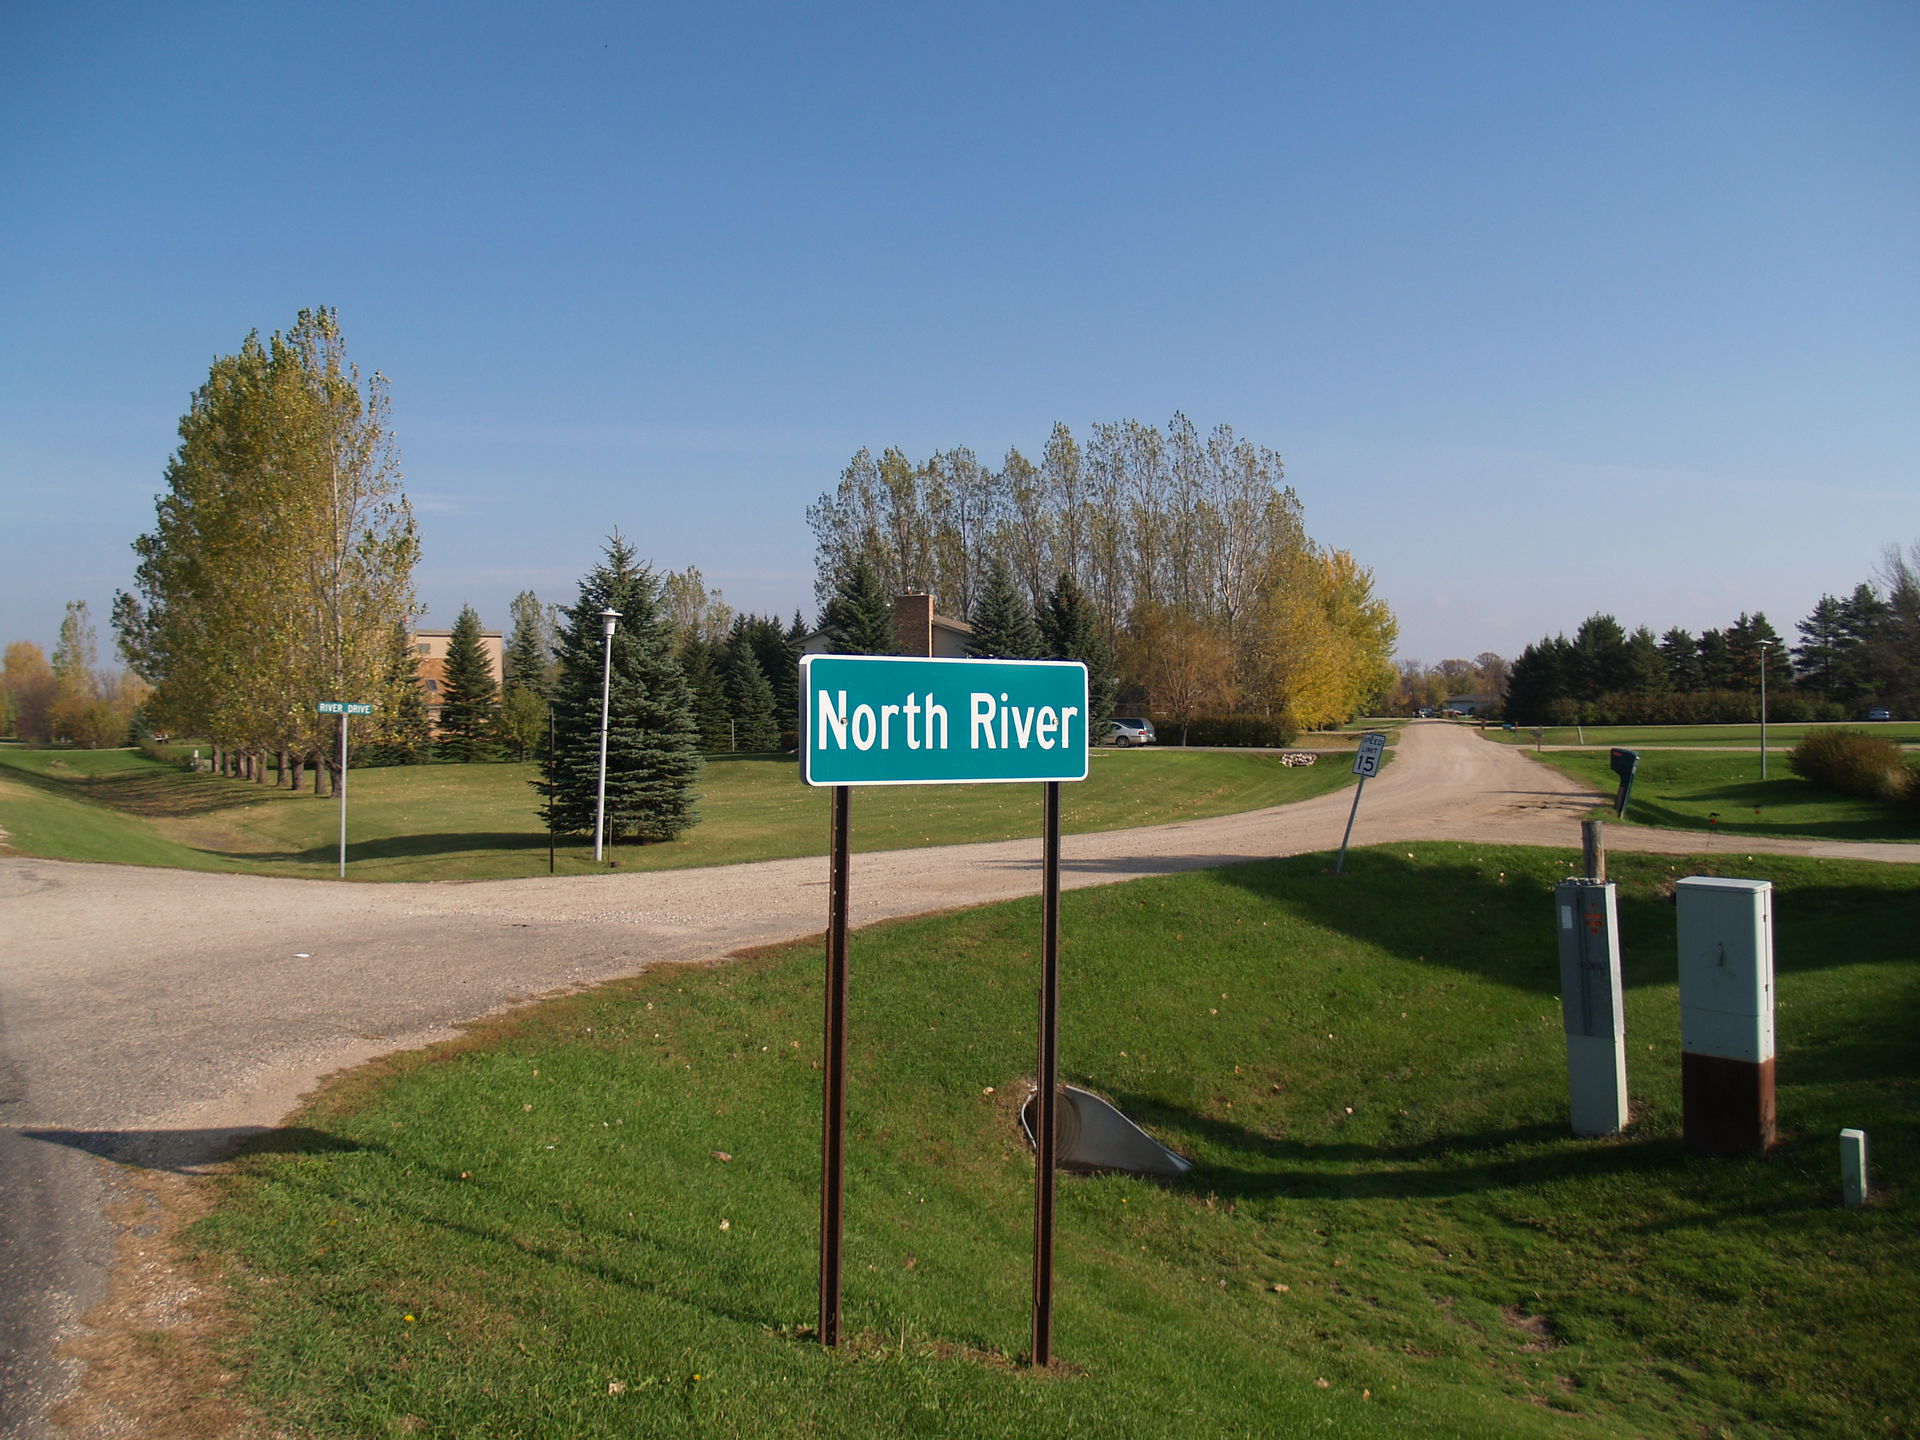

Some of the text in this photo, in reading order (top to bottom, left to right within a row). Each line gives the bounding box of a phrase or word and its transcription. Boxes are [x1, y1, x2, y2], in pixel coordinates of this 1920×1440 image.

[320, 703, 370, 713] RIVER DRIVE
[818, 690, 1078, 751] North River
[1361, 745, 1378, 754] LIMIT
[1357, 755, 1375, 771] 15
